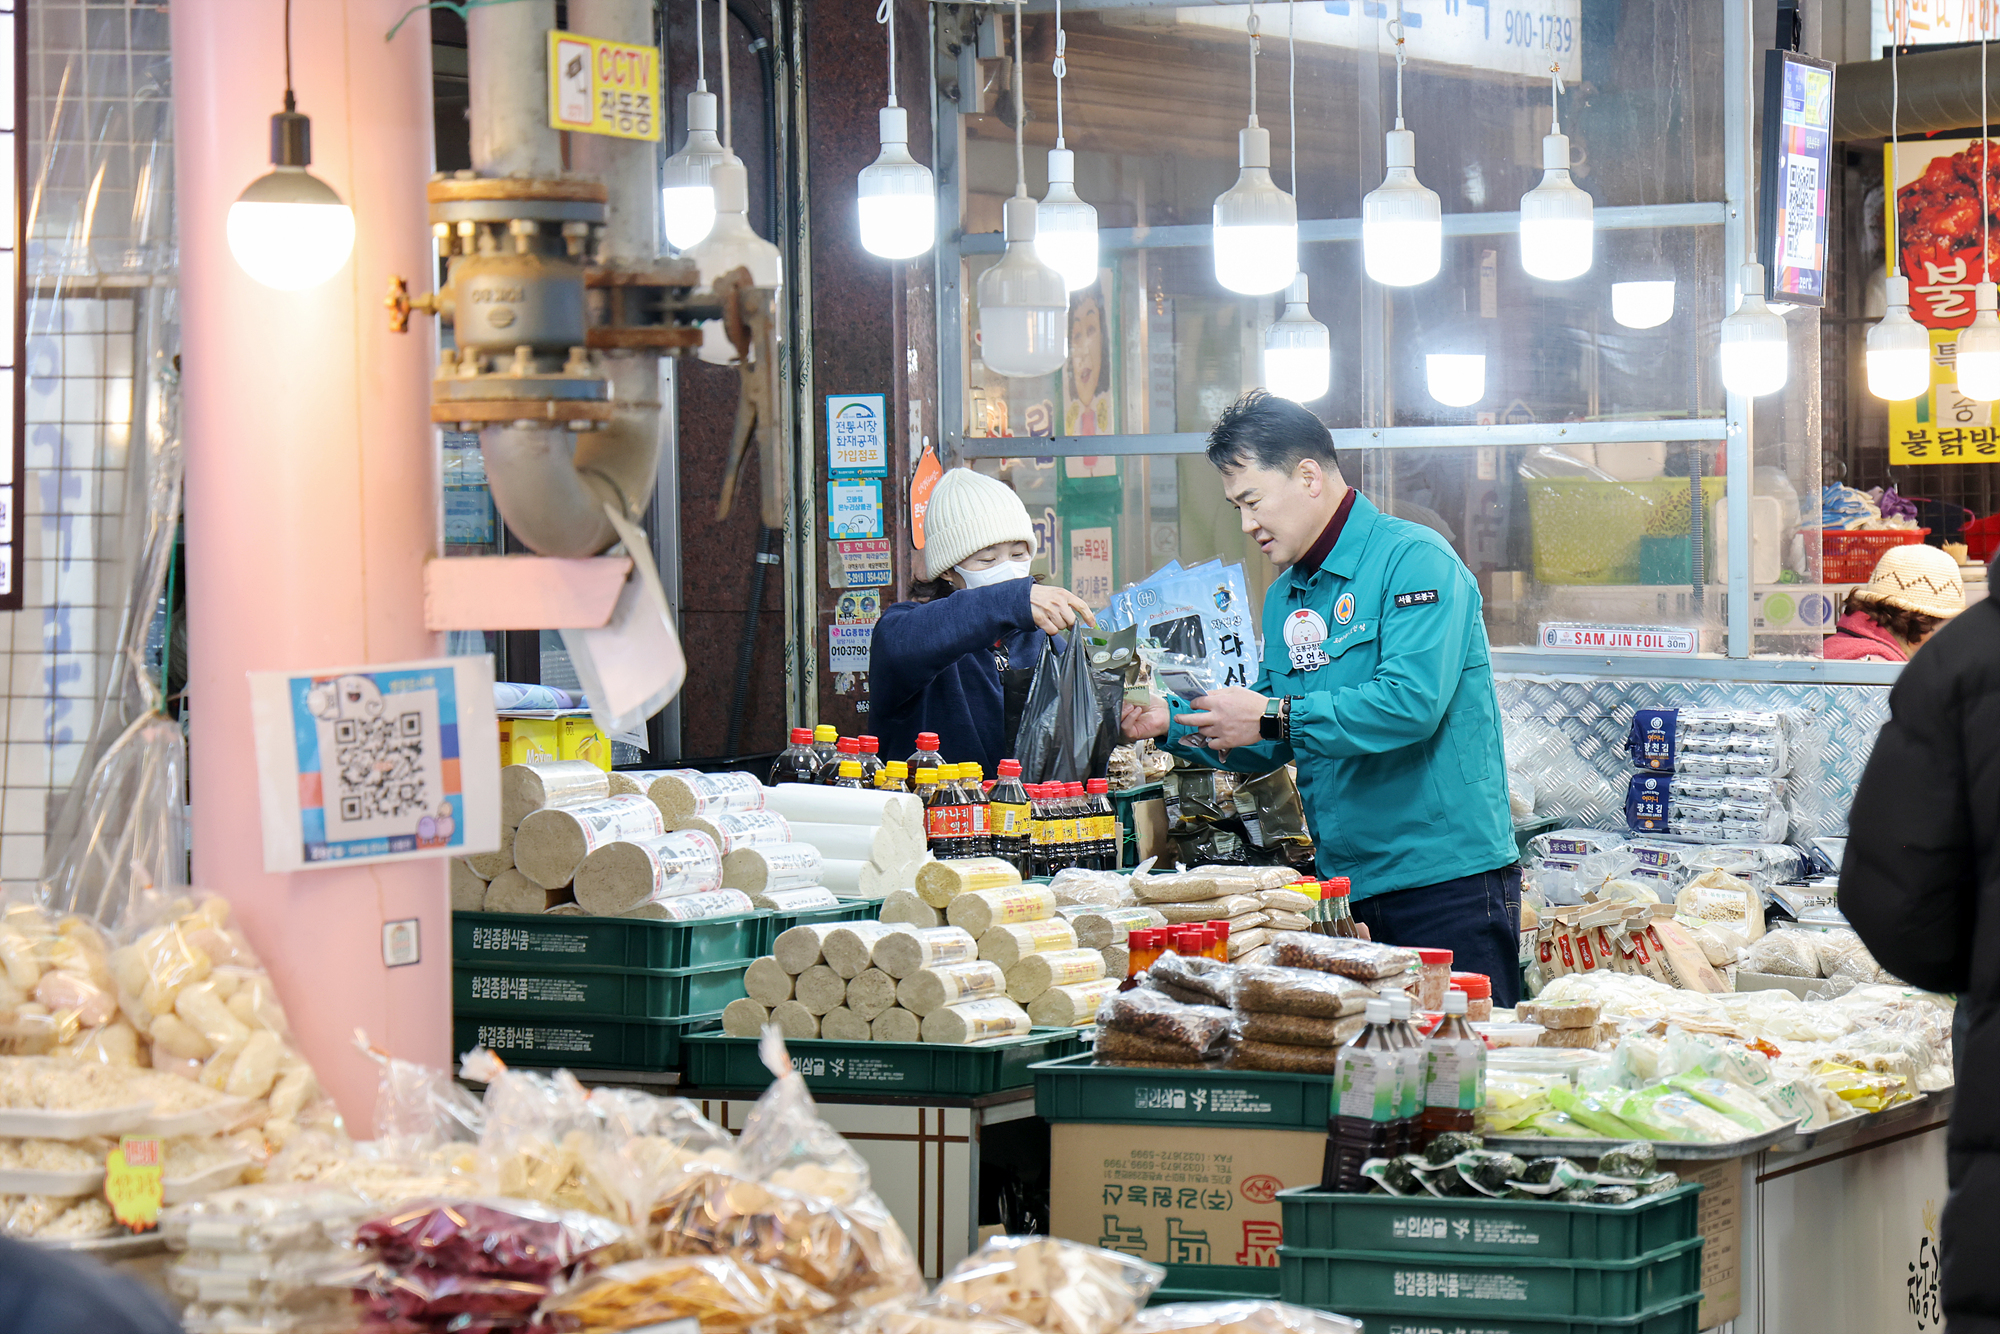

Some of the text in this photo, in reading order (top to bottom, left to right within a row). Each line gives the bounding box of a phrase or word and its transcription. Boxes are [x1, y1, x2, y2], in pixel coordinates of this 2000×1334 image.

[598, 46, 651, 88] CCTV
[600, 90, 650, 134] 작동중
[1914, 257, 1976, 318] 불
[835, 420, 878, 434] 전통시장
[836, 435, 878, 448] 화재공제
[837, 449, 879, 462] 가입점포
[1085, 539, 1109, 562] 목요일
[1398, 591, 1435, 605] 서울 도봉구
[1575, 631, 1664, 648] SAM JIN FOIL
[1667, 640, 1686, 648] 30m
[526, 748, 553, 764] Maxim
[936, 807, 969, 821] 까나리
[1637, 803, 1663, 813] 광천김
[1212, 1153, 1233, 1163] FAX
[1216, 1164, 1232, 1173] TEL
[1102, 1184, 1234, 1211] (주)강원농산
